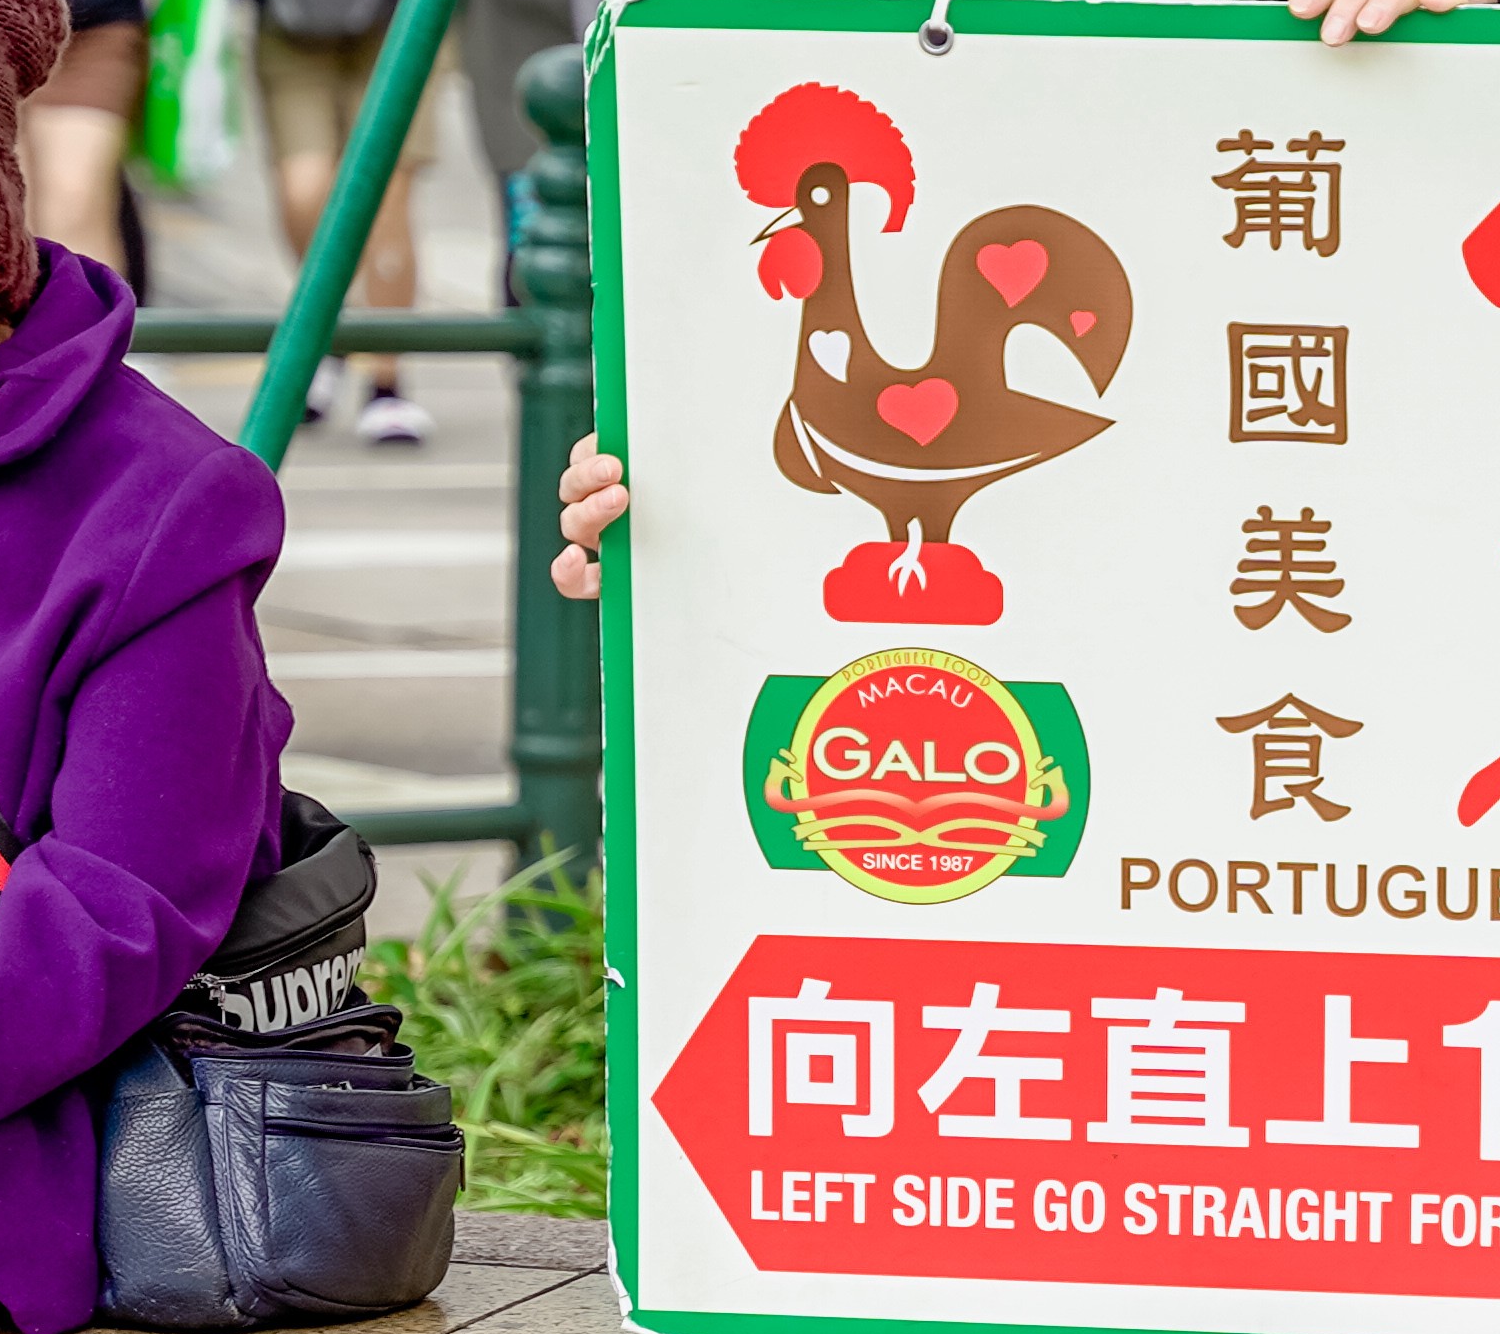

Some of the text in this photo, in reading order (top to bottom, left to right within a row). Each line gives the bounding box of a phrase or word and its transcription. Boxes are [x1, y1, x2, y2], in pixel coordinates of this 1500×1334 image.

[1211, 128, 1364, 823] 葡國美食
[842, 651, 992, 687] PORTUGUESE FOOD
[857, 673, 974, 708] MACAU
[812, 726, 1021, 785] GALO
[862, 852, 973, 872] SINCE 1987
[750, 1169, 876, 1223] LEFT
[892, 1174, 1015, 1230] SIDE
[1033, 1179, 1106, 1234] GO
[1123, 1181, 1392, 1243] STRAIGHT
